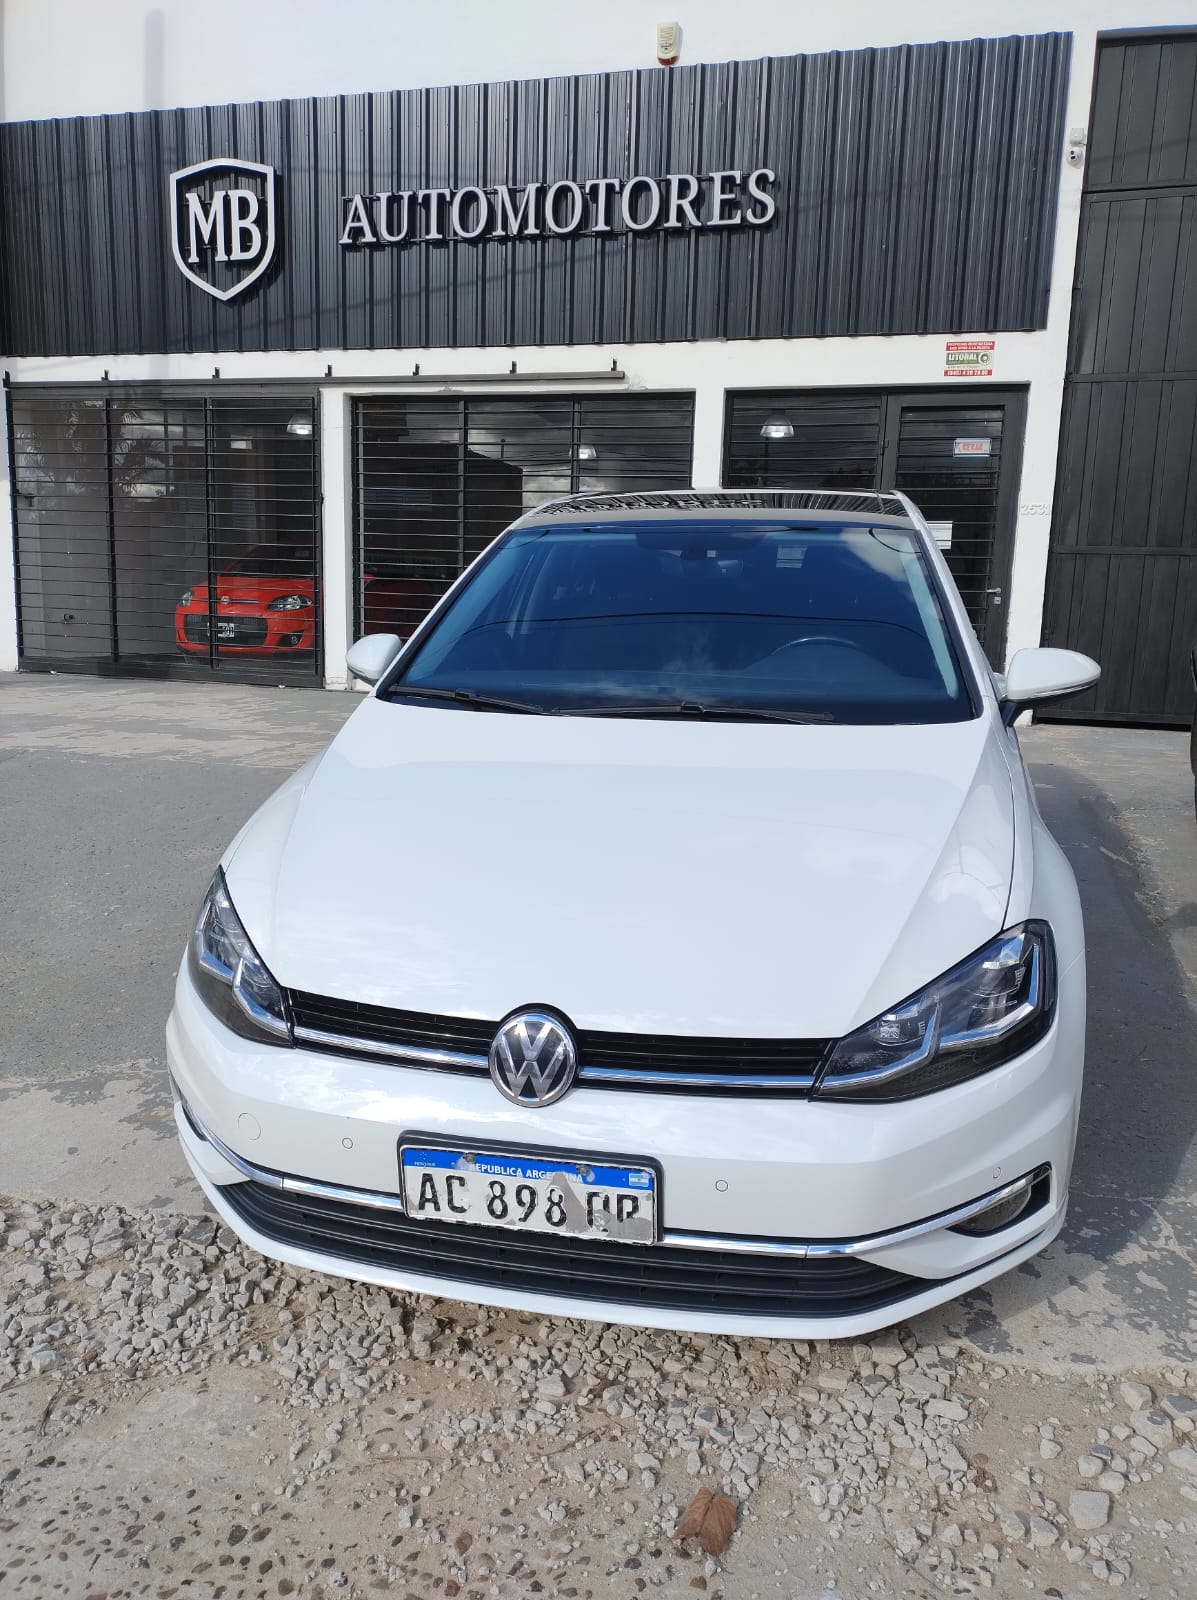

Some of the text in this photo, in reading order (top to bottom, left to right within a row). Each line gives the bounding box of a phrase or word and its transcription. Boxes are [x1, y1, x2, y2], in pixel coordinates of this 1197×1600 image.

[185, 189, 262, 263] MB
[339, 168, 776, 245] AUTOMOTORES
[948, 353, 977, 361] LITORAL
[418, 1172, 468, 1213] AC
[487, 1180, 567, 1227] 898
